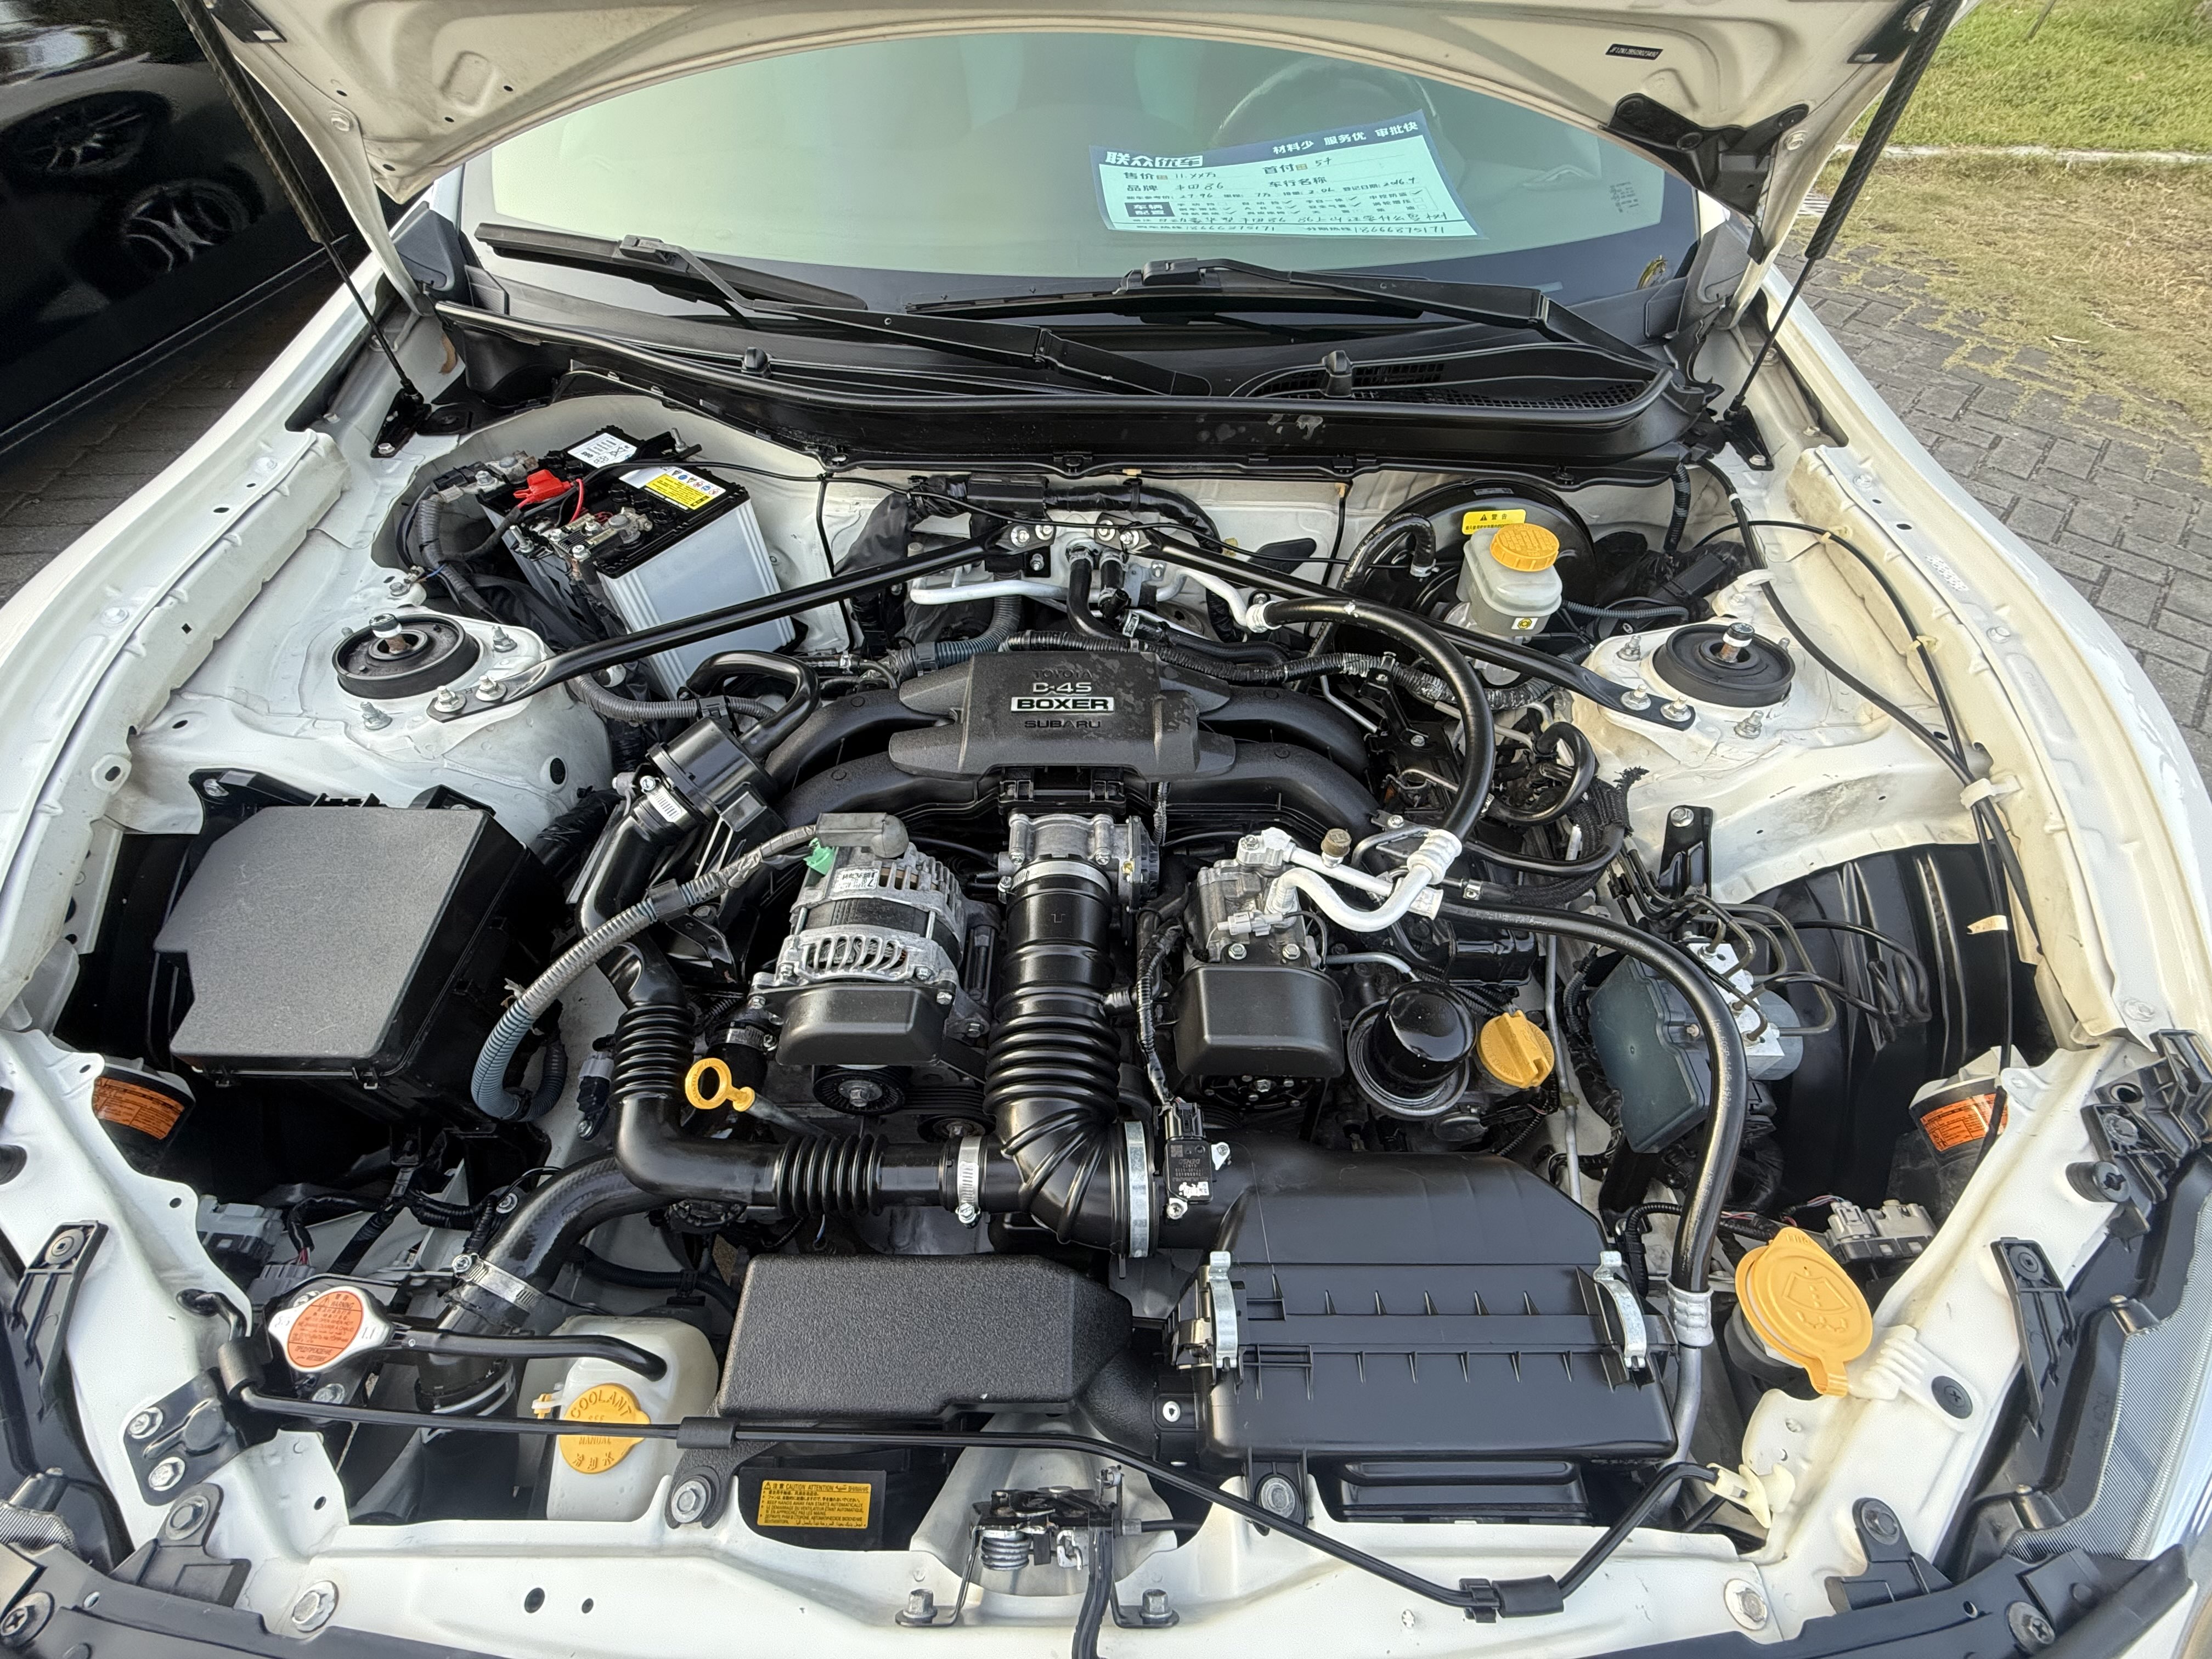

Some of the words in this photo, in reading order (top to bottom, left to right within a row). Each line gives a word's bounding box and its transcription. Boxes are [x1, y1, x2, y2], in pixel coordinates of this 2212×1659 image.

[1272, 140, 1314, 155] 材料少
[1323, 131, 1367, 146] 服务优
[1374, 121, 1419, 138] 审批快
[1105, 150, 1202, 167] 联众优车
[1262, 163, 1295, 175] 首付
[1123, 172, 1154, 180] 售价
[1268, 176, 1328, 188] 车行名称
[1126, 184, 1159, 192] 品牌
[1032, 669, 1093, 679] TOYOTA
[1017, 698, 1109, 710] BOXER
[1024, 719, 1102, 729] SUBARU
[571, 1389, 633, 1419] COOLANT
[578, 1435, 612, 1446] MANUAL
[572, 1451, 615, 1471] 冷却水
